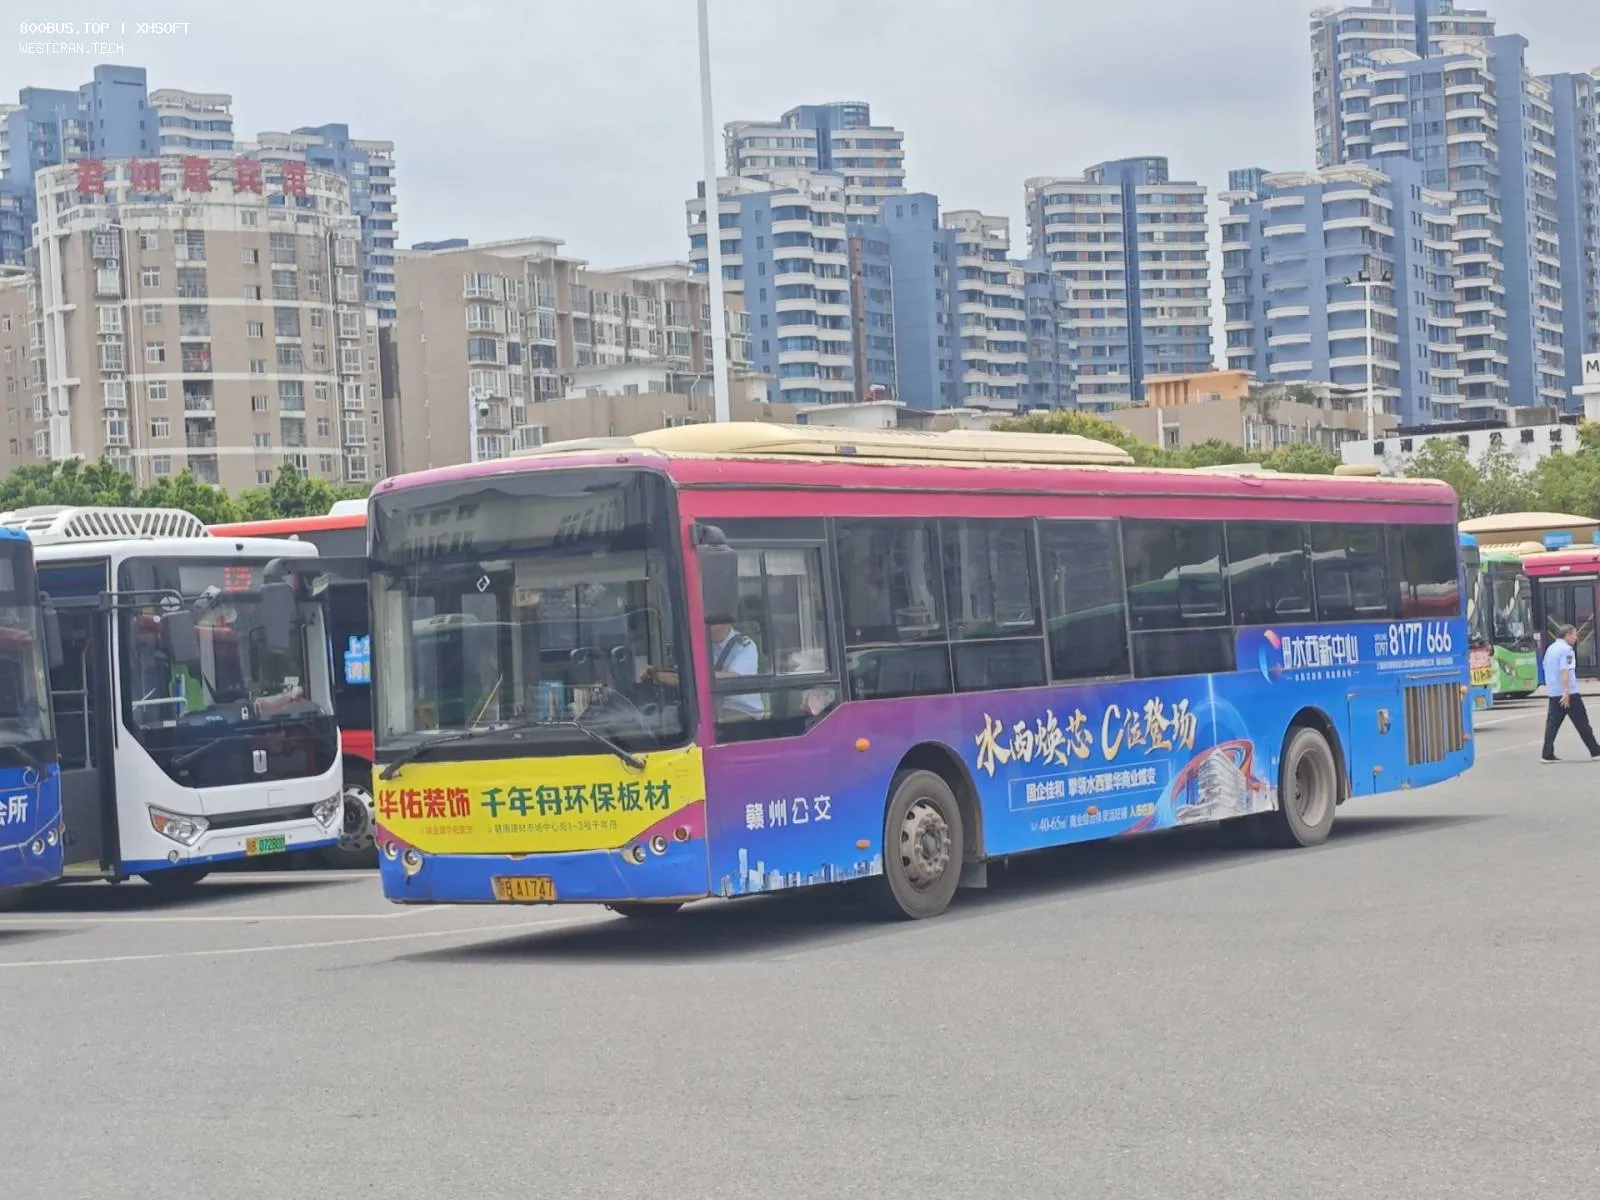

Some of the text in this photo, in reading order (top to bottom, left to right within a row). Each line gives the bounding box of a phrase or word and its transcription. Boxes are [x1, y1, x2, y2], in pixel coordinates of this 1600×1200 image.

[1388, 623, 1422, 656] 8177
[1426, 621, 1452, 653] 666
[975, 696, 1197, 777] 水西焕芯 C位登场
[379, 779, 671, 819] 华佑装饰 千年舟环保板材
[745, 794, 832, 830] 赣州公交
